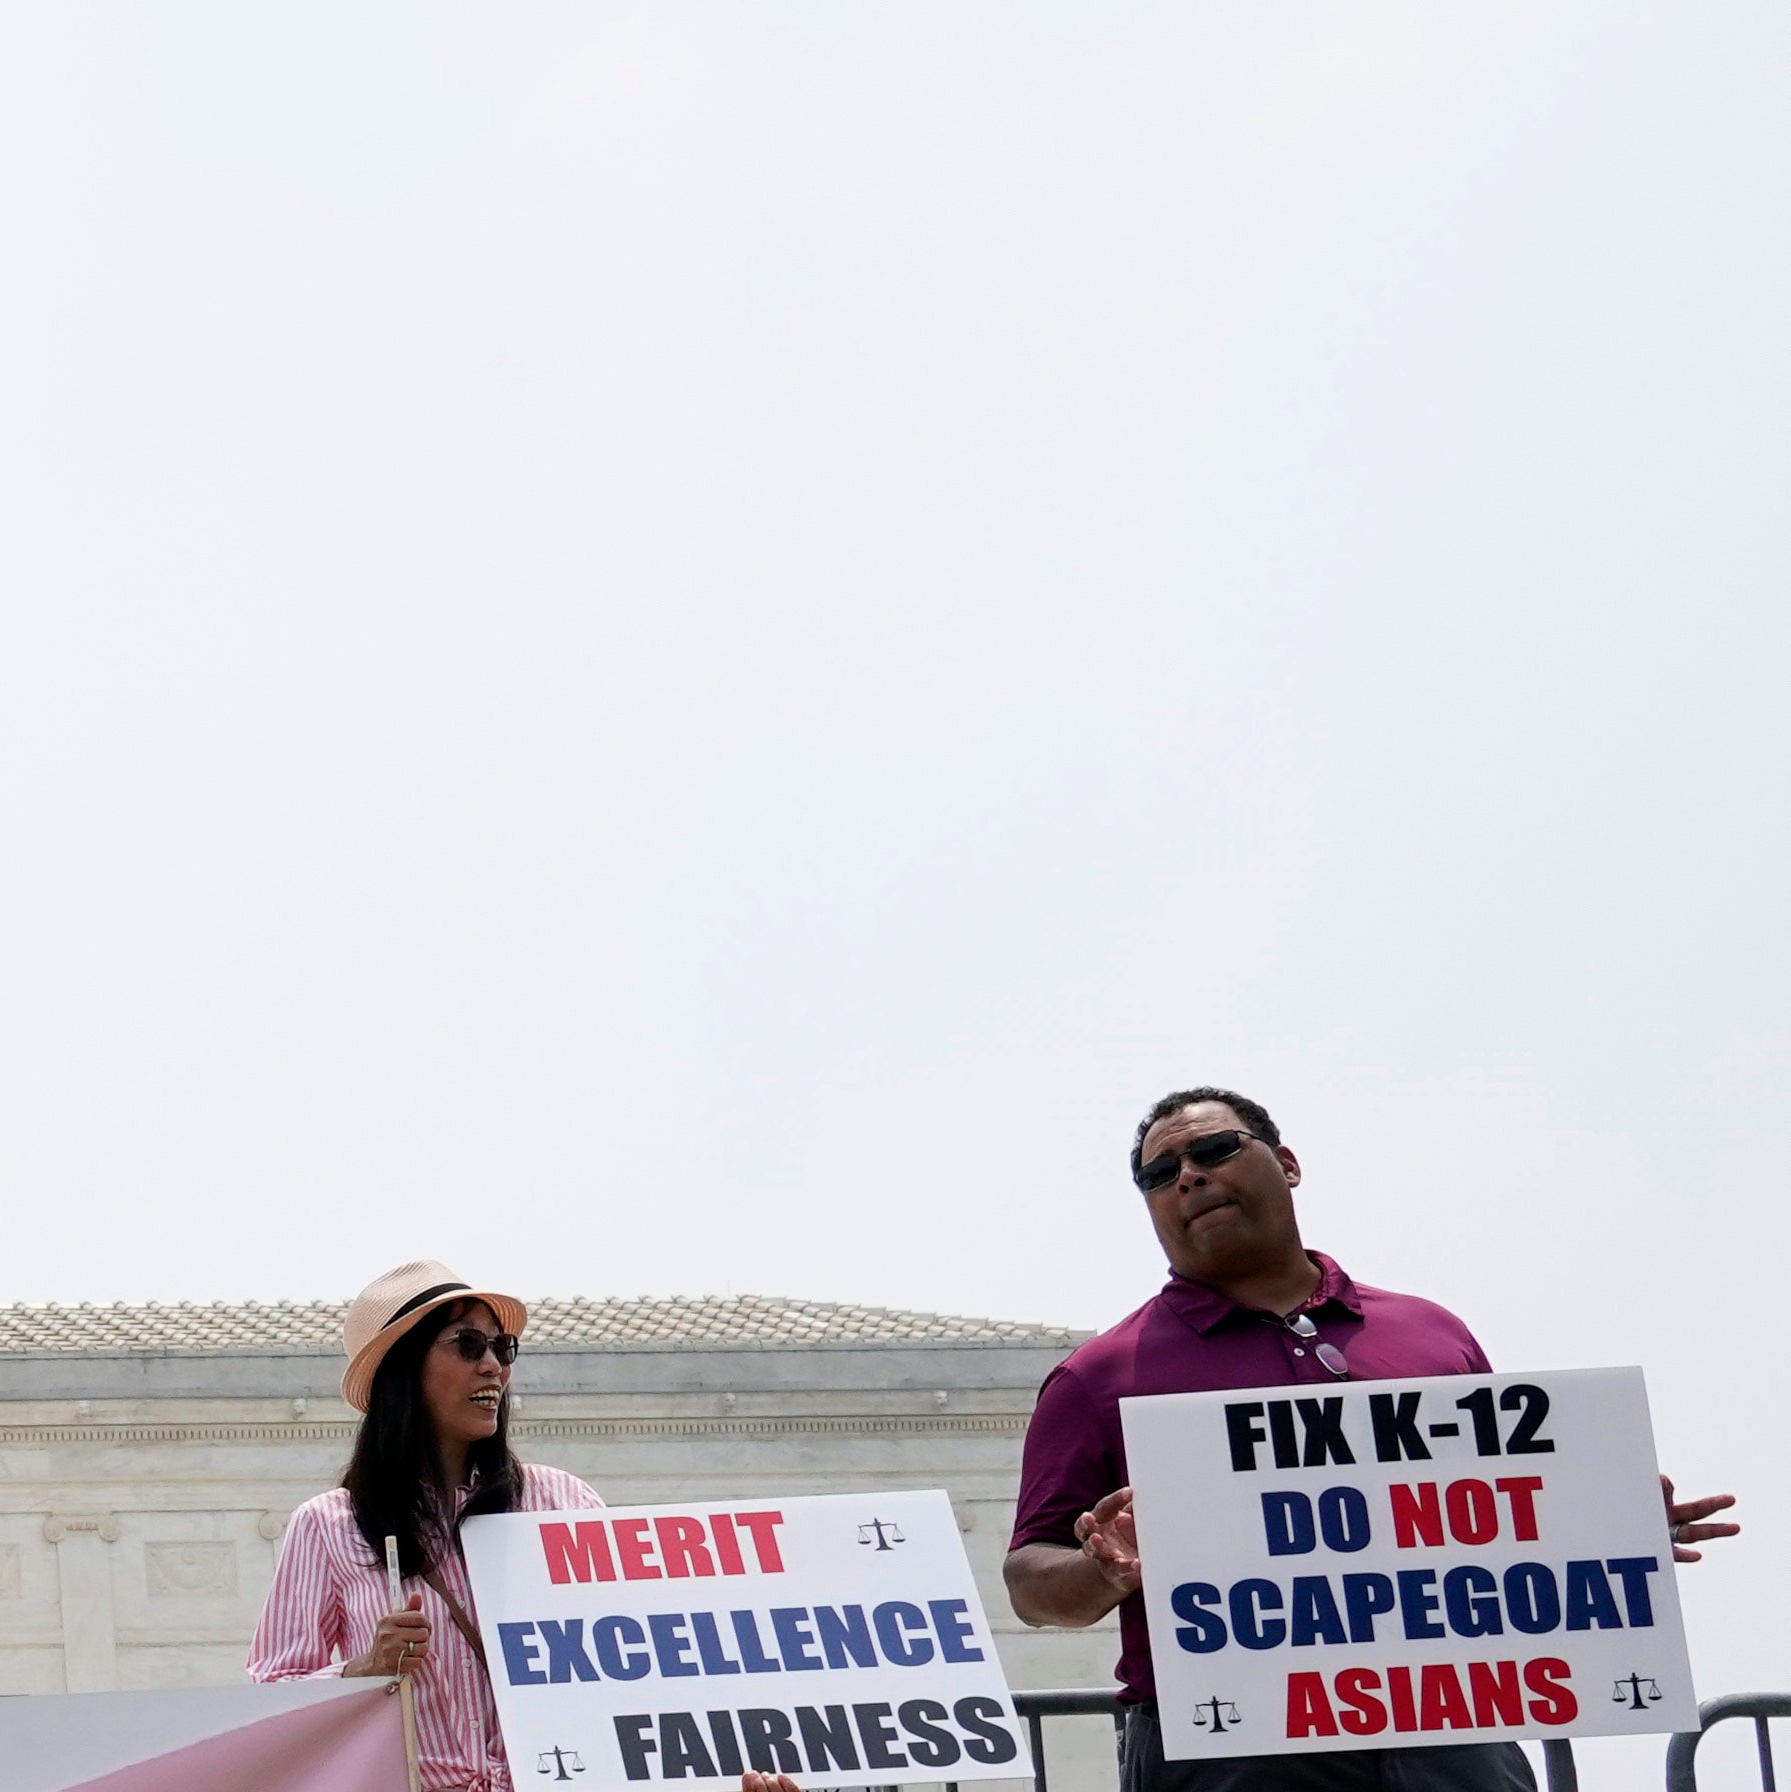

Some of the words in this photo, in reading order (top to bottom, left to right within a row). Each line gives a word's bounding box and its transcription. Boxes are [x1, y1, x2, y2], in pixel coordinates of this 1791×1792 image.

[1224, 1397, 1357, 1472] FIX
[1369, 1384, 1555, 1464] K-12
[538, 1511, 785, 1585] MERIT
[1261, 1486, 1371, 1556] DO
[1388, 1476, 1543, 1549] NOT
[497, 1598, 985, 1686] EXCELLENCE
[1171, 1556, 1660, 1655] SCAPEGOAT
[613, 1696, 1018, 1781] FAIRNESS
[1285, 1657, 1579, 1738] ASIANS
